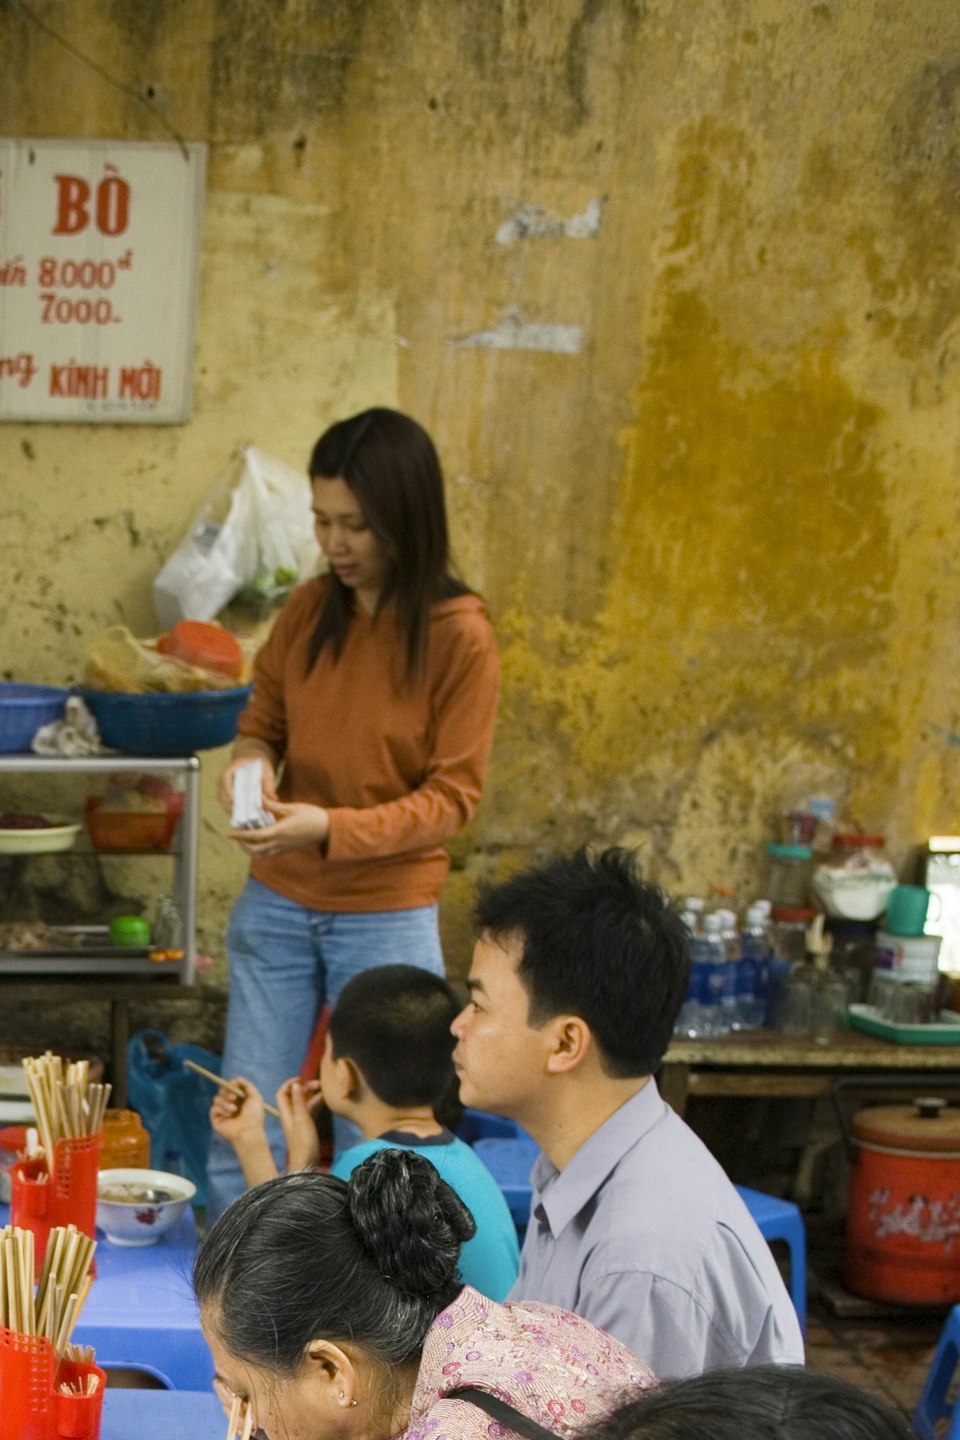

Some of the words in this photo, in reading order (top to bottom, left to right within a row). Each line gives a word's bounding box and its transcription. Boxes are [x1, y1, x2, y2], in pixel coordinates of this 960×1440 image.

[52, 163, 131, 236] BÒ
[49, 357, 109, 400] KÍNH
[118, 358, 162, 401] MỜI
